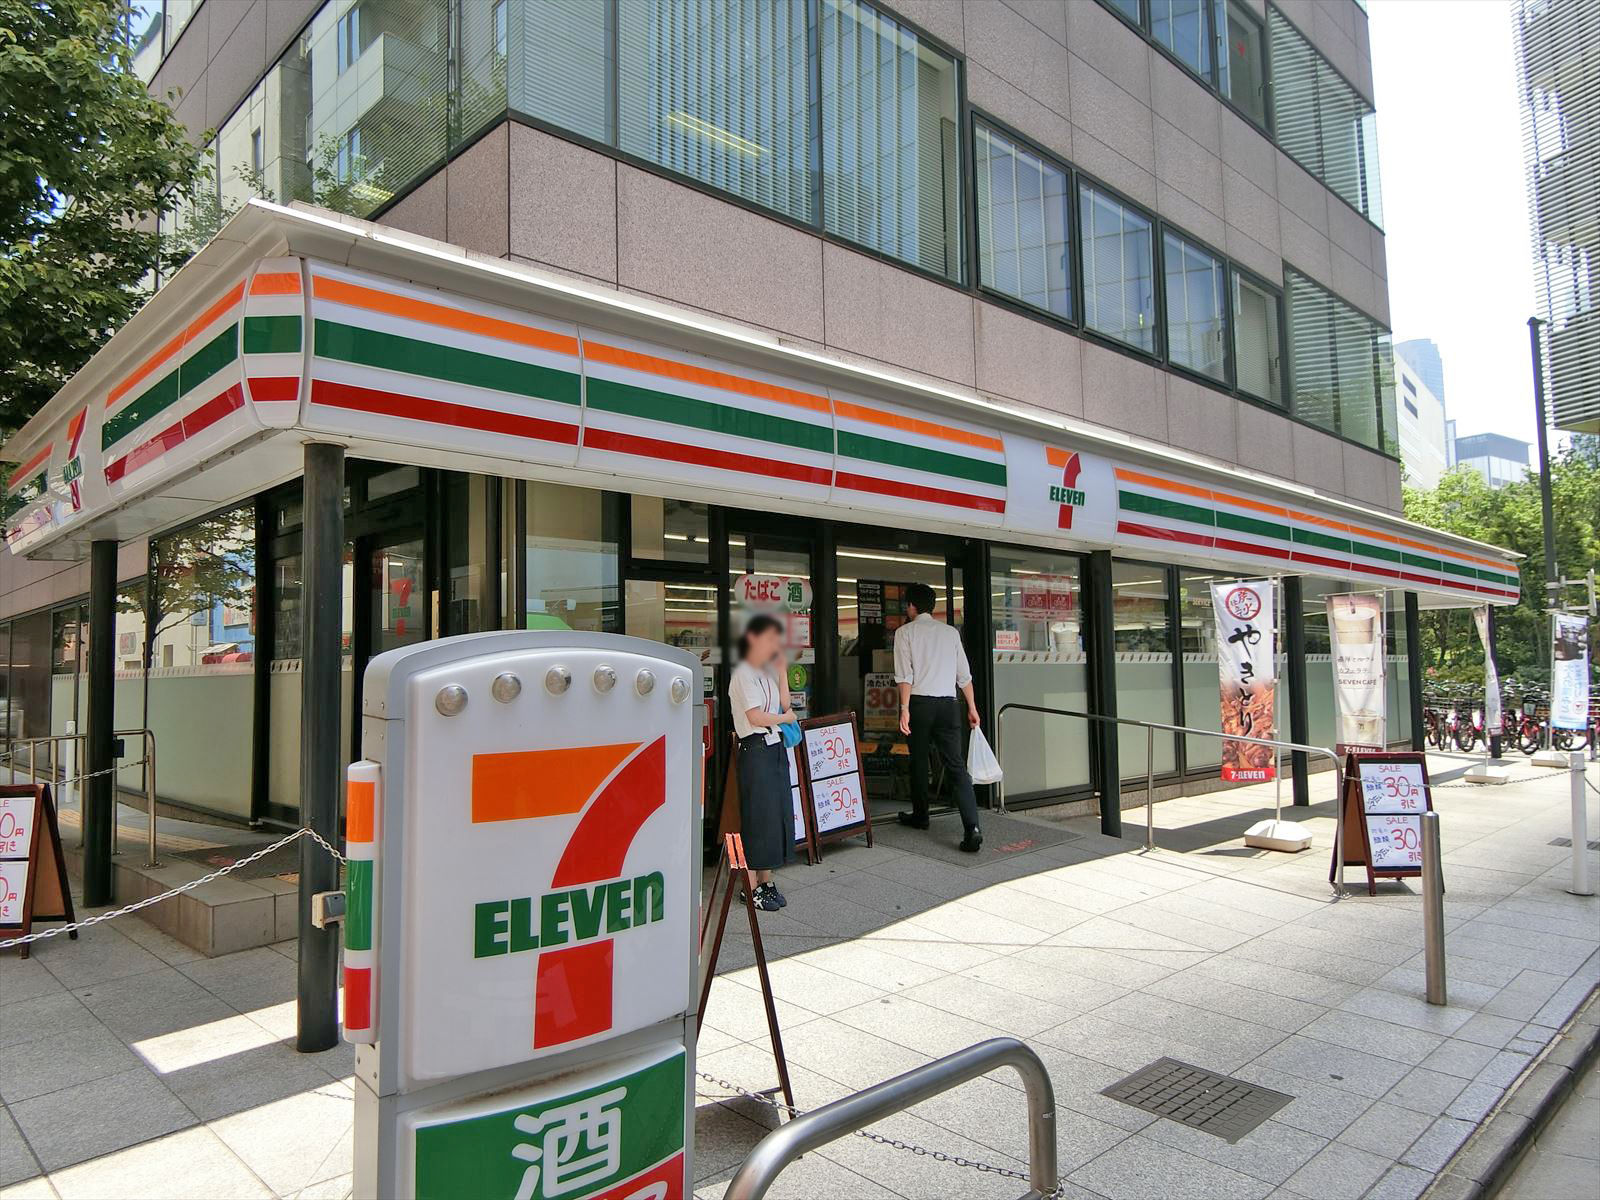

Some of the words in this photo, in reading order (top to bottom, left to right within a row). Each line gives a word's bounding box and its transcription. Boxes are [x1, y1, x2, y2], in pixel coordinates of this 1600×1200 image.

[1045, 447, 1081, 529] 7
[745, 580, 780, 601] たばこ
[788, 582, 802, 602] 酒
[1228, 624, 1261, 736] やきとり
[820, 727, 838, 737] SALE
[1379, 765, 1402, 773] SALE
[826, 778, 844, 788] SALE
[1386, 817, 1408, 825] SALE
[1391, 828, 1421, 850] 30
[472, 734, 666, 1049] 7
[511, 1086, 627, 1200] 酒
